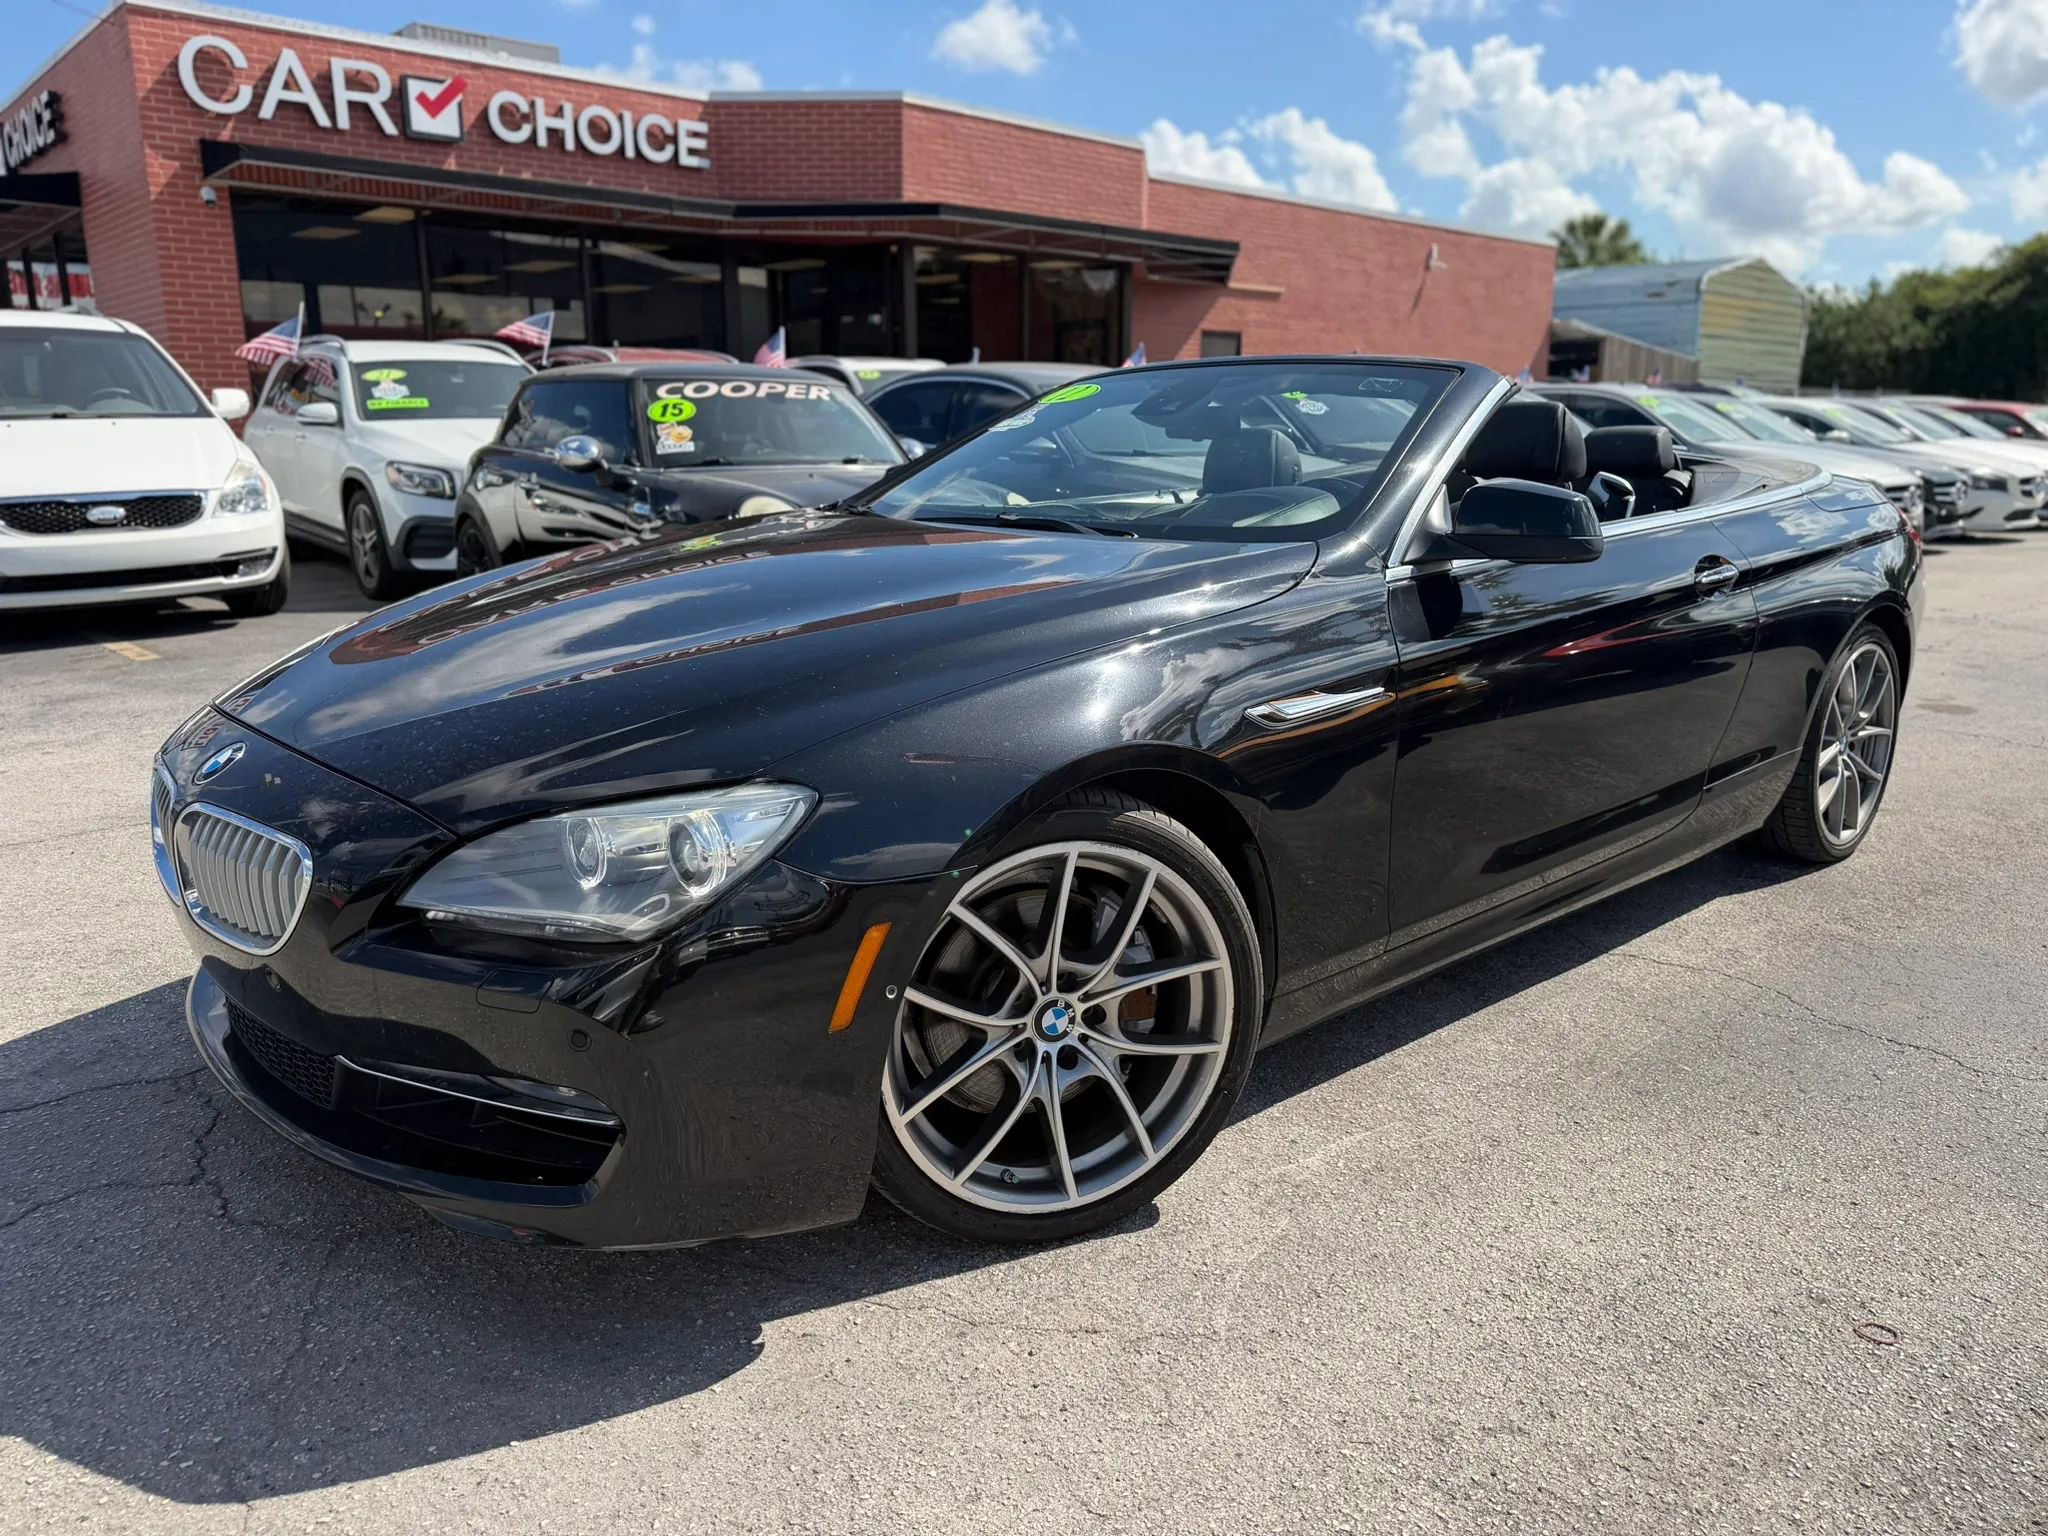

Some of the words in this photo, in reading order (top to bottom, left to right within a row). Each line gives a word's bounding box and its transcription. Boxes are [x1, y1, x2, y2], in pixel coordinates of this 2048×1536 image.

[177, 34, 399, 136] CAR
[487, 90, 711, 169] CHOICE
[3, 90, 56, 168] CHOICE
[656, 381, 831, 400] COOPER
[660, 402, 684, 418] 15
[1057, 1000, 1075, 1033] BMW
